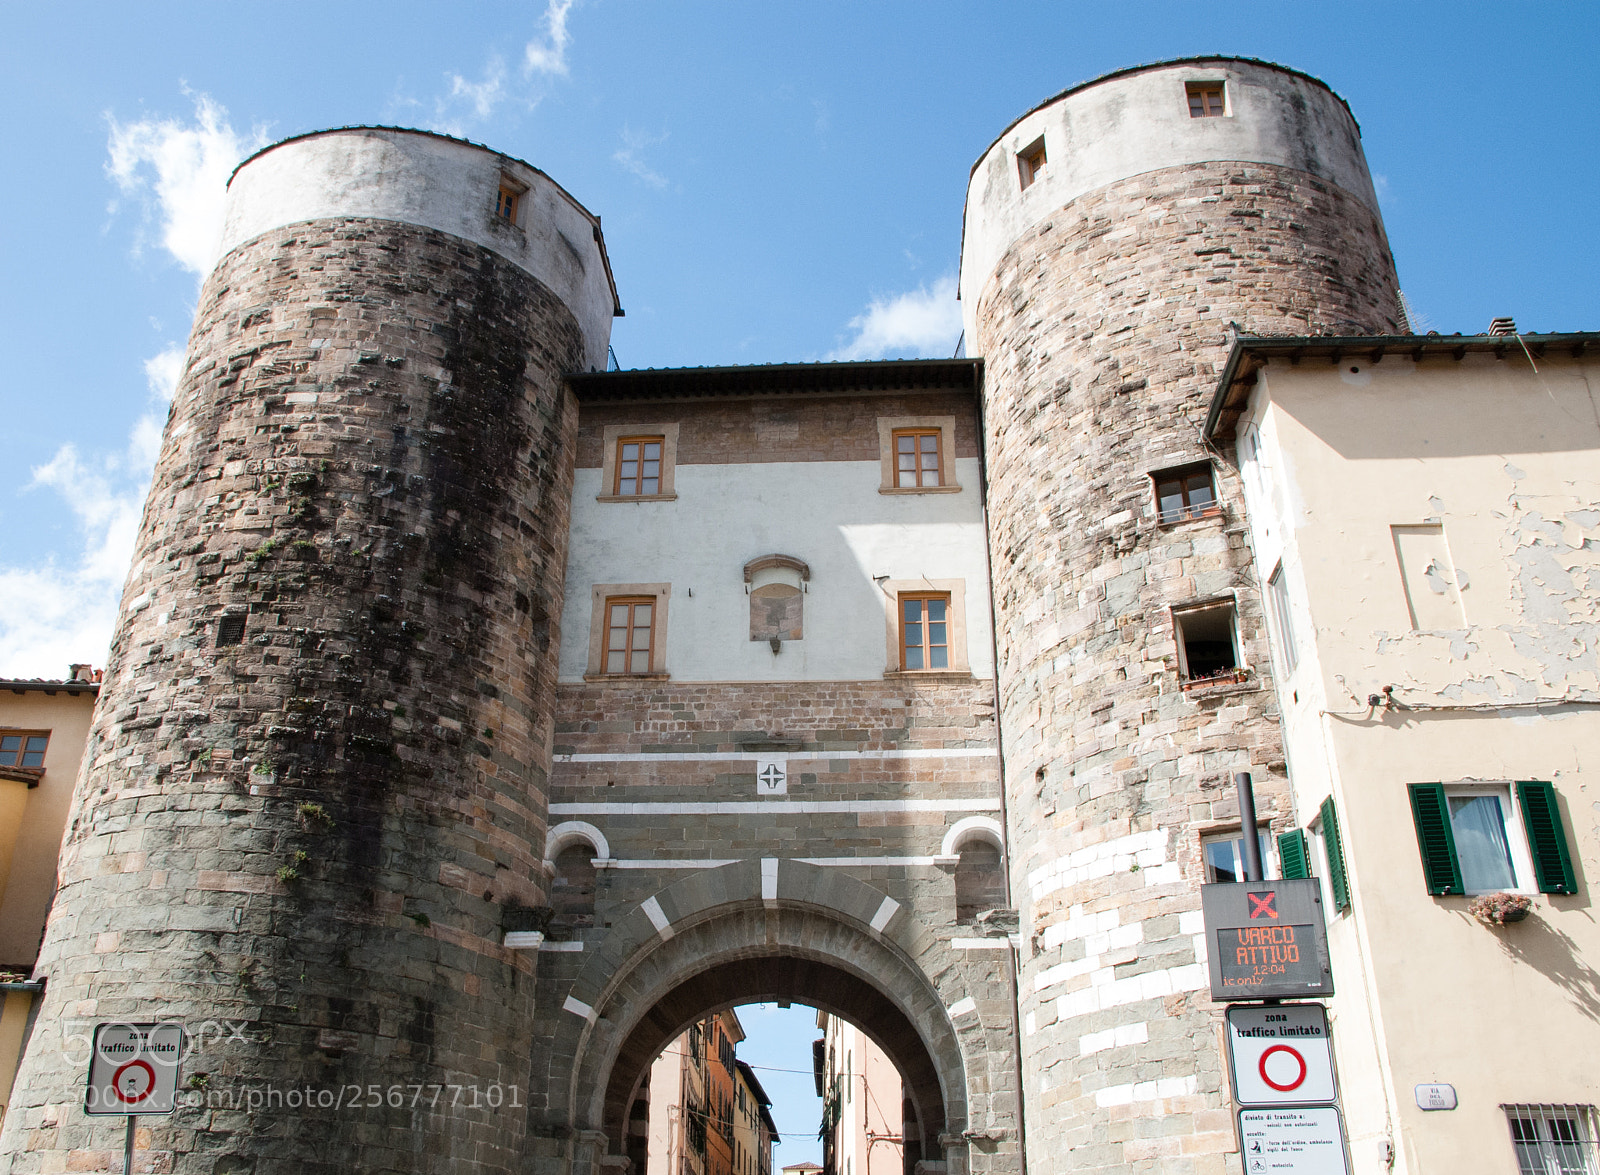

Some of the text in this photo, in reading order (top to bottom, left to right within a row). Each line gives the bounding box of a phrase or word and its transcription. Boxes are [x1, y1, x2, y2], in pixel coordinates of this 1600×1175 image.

[1237, 926, 1295, 945] VARCO
[1236, 944, 1300, 965] ATTIVO
[1253, 964, 1286, 976] 12:04
[1237, 975, 1264, 986] only
[1264, 1014, 1288, 1022] zona
[1236, 1025, 1321, 1038] traffico limitato
